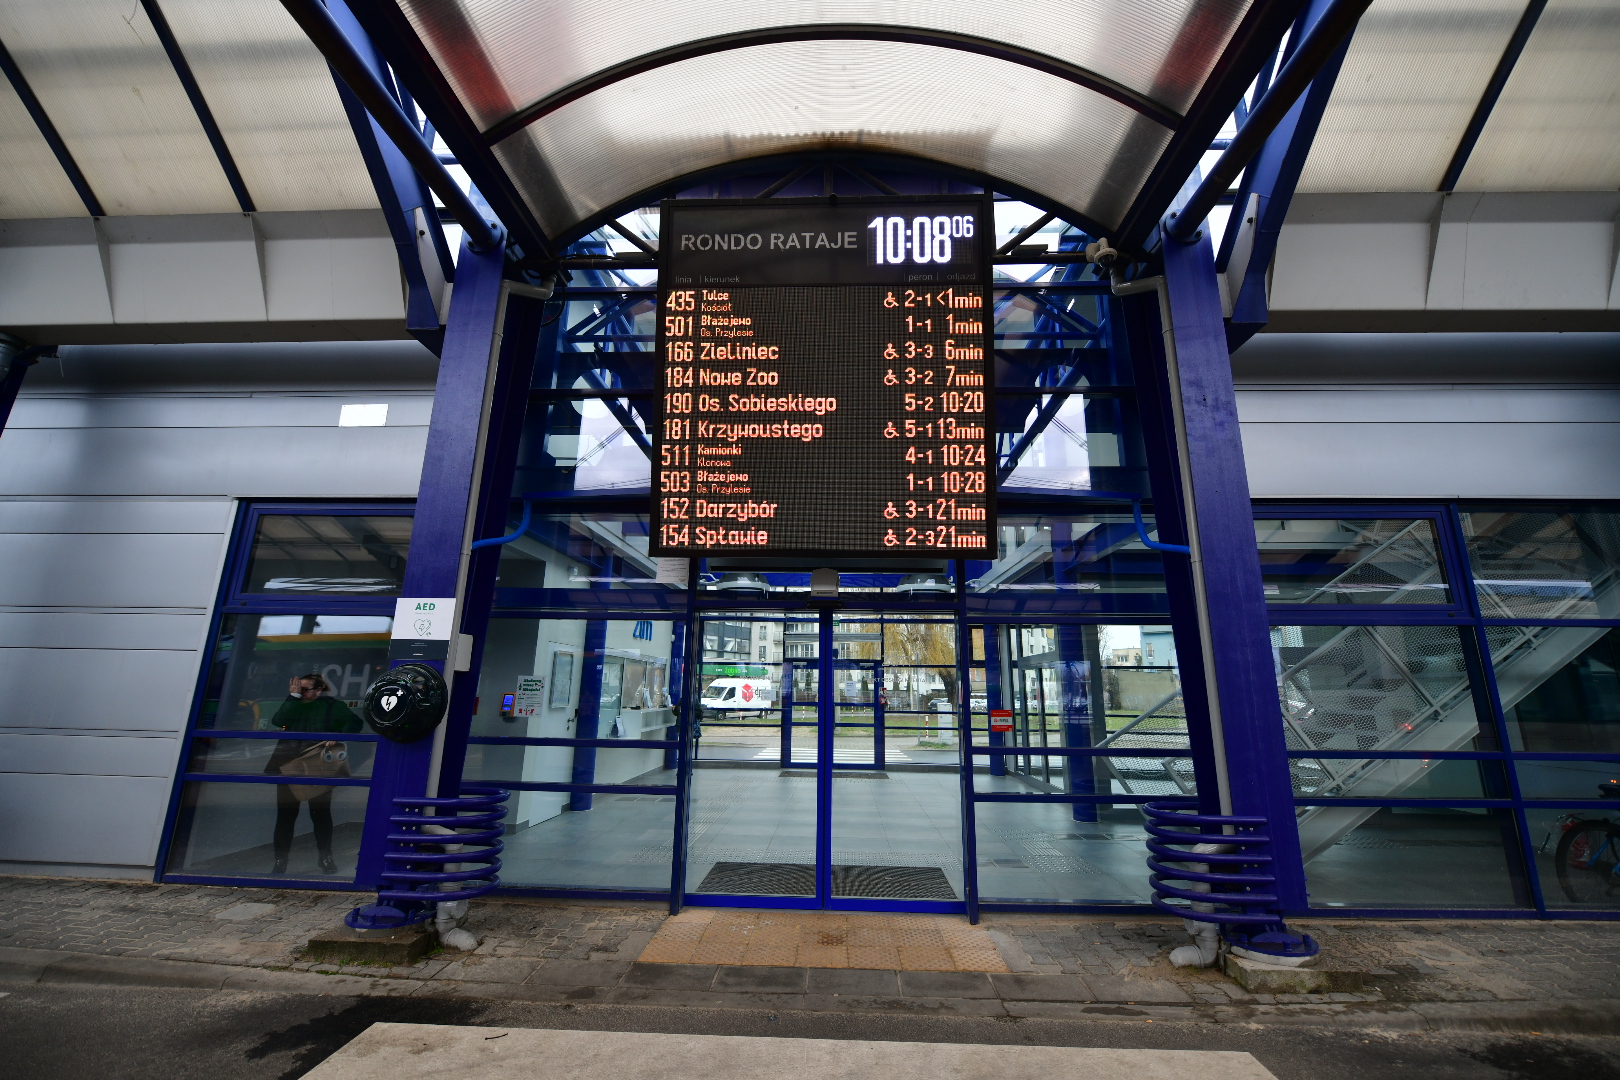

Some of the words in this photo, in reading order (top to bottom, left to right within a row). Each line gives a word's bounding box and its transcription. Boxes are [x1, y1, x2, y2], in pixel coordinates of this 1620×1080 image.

[680, 233, 762, 251] RONDO
[770, 231, 858, 250] RATAJE
[868, 216, 951, 264] 10:08
[953, 215, 974, 238] 06
[675, 275, 692, 284] linia
[704, 275, 740, 284] kierunek
[908, 273, 933, 283] peron
[666, 291, 695, 311] 435
[702, 290, 729, 300] Tulce
[905, 290, 930, 307] 2-1
[666, 316, 692, 336] 501
[701, 315, 751, 327] Błażejewo
[906, 316, 931, 332] 1-1
[946, 314, 982, 334] 1min
[716, 328, 753, 338] Przylesie
[666, 342, 693, 361] 166
[700, 343, 778, 360] Zieliniec
[905, 341, 933, 358] 3-3
[945, 340, 983, 360] 6min
[666, 367, 693, 387] 184
[700, 369, 742, 385] Nowe
[747, 368, 778, 385] Zoo
[905, 367, 933, 384] 3-2
[946, 365, 983, 386] 7min
[664, 393, 692, 413] 190
[729, 394, 836, 415] Sobieskiego
[905, 393, 933, 411] 5-2
[940, 392, 983, 412] 10:20
[664, 419, 689, 439] 181
[698, 420, 823, 442] Krzywoustego
[905, 420, 932, 437] 5-1
[937, 418, 984, 439] 13min
[662, 445, 689, 465] 511
[698, 444, 741, 455] Kamionki
[906, 446, 932, 464] 4-1
[941, 445, 985, 466] 10:24
[661, 471, 690, 492] 503
[697, 470, 748, 483] Błażejewo
[906, 473, 932, 491] 1-1
[941, 472, 985, 493] 10:28
[712, 484, 750, 495] Przylesie
[661, 498, 689, 519] 152
[696, 500, 777, 521] Darzybór
[937, 498, 985, 520] 21min
[660, 524, 689, 546] 154
[696, 526, 767, 547] Spławie
[937, 526, 986, 547] 21min
[415, 603, 436, 611] AED
